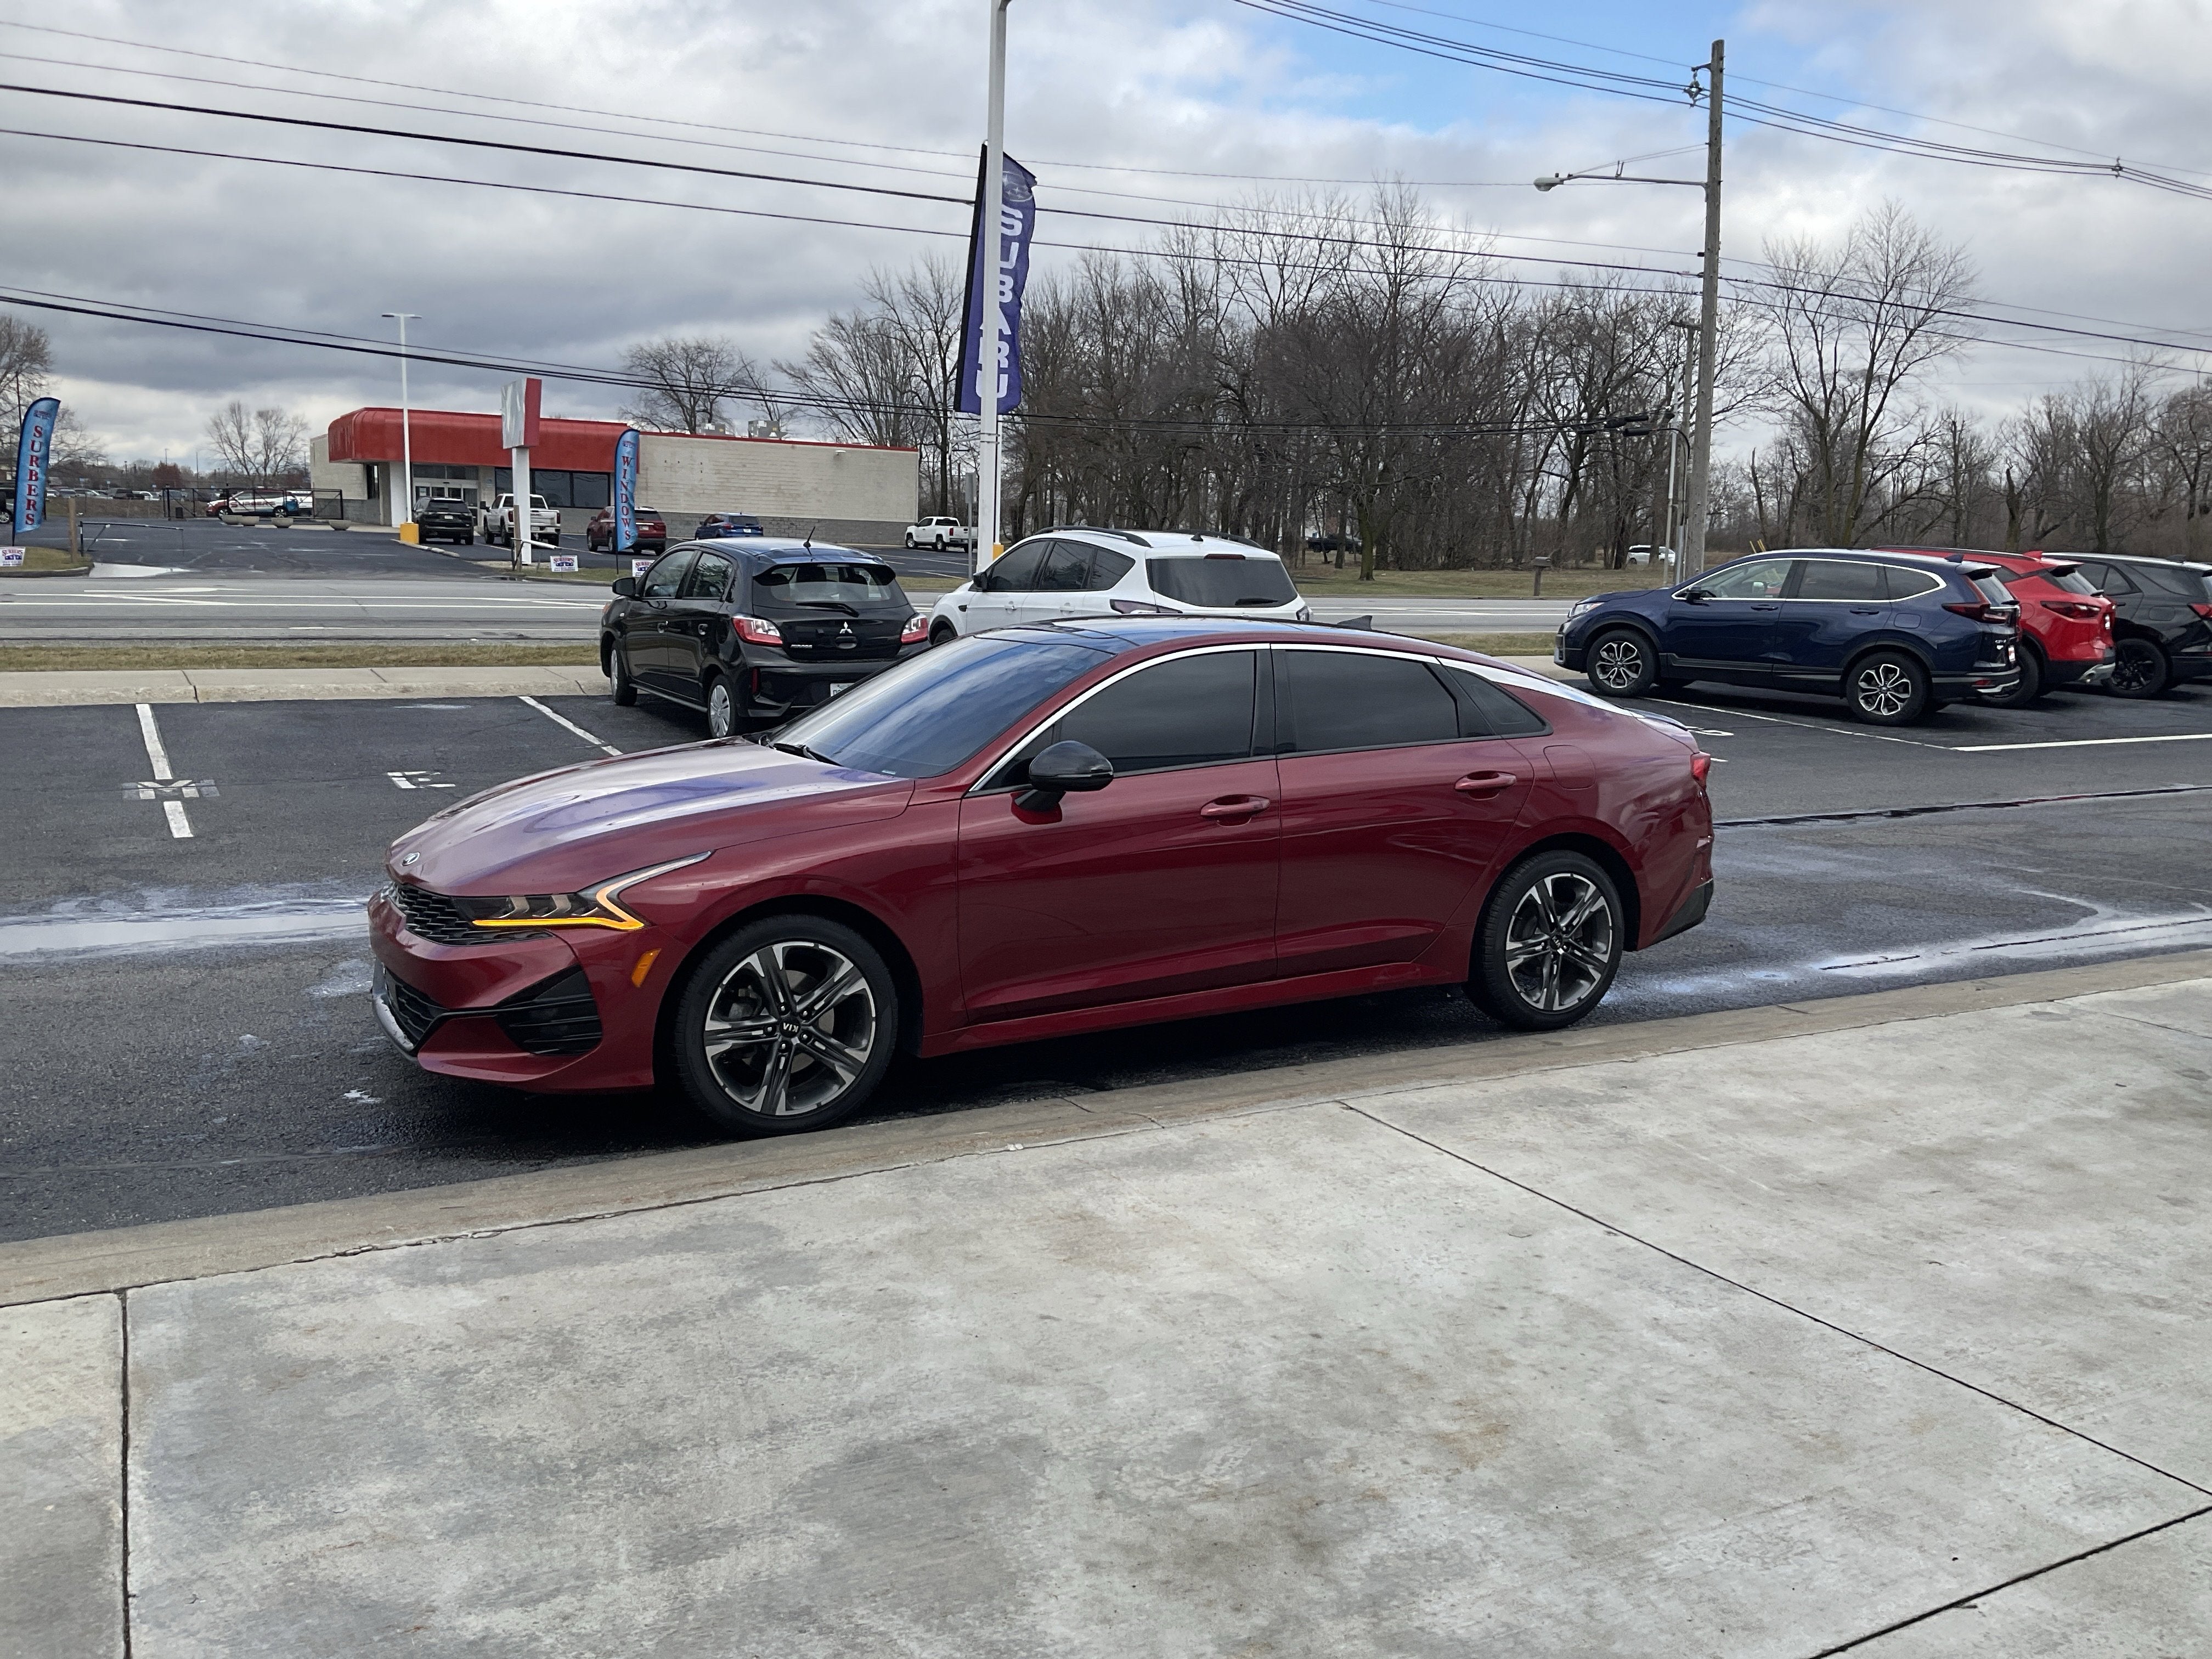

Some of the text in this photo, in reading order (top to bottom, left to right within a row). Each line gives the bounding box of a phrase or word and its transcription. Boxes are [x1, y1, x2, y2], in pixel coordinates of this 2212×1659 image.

[975, 204, 1023, 398] SUBARU
[25, 425, 42, 525] SURBERS
[620, 455, 634, 540] WINDOWS
[783, 1022, 799, 1032] KIA
